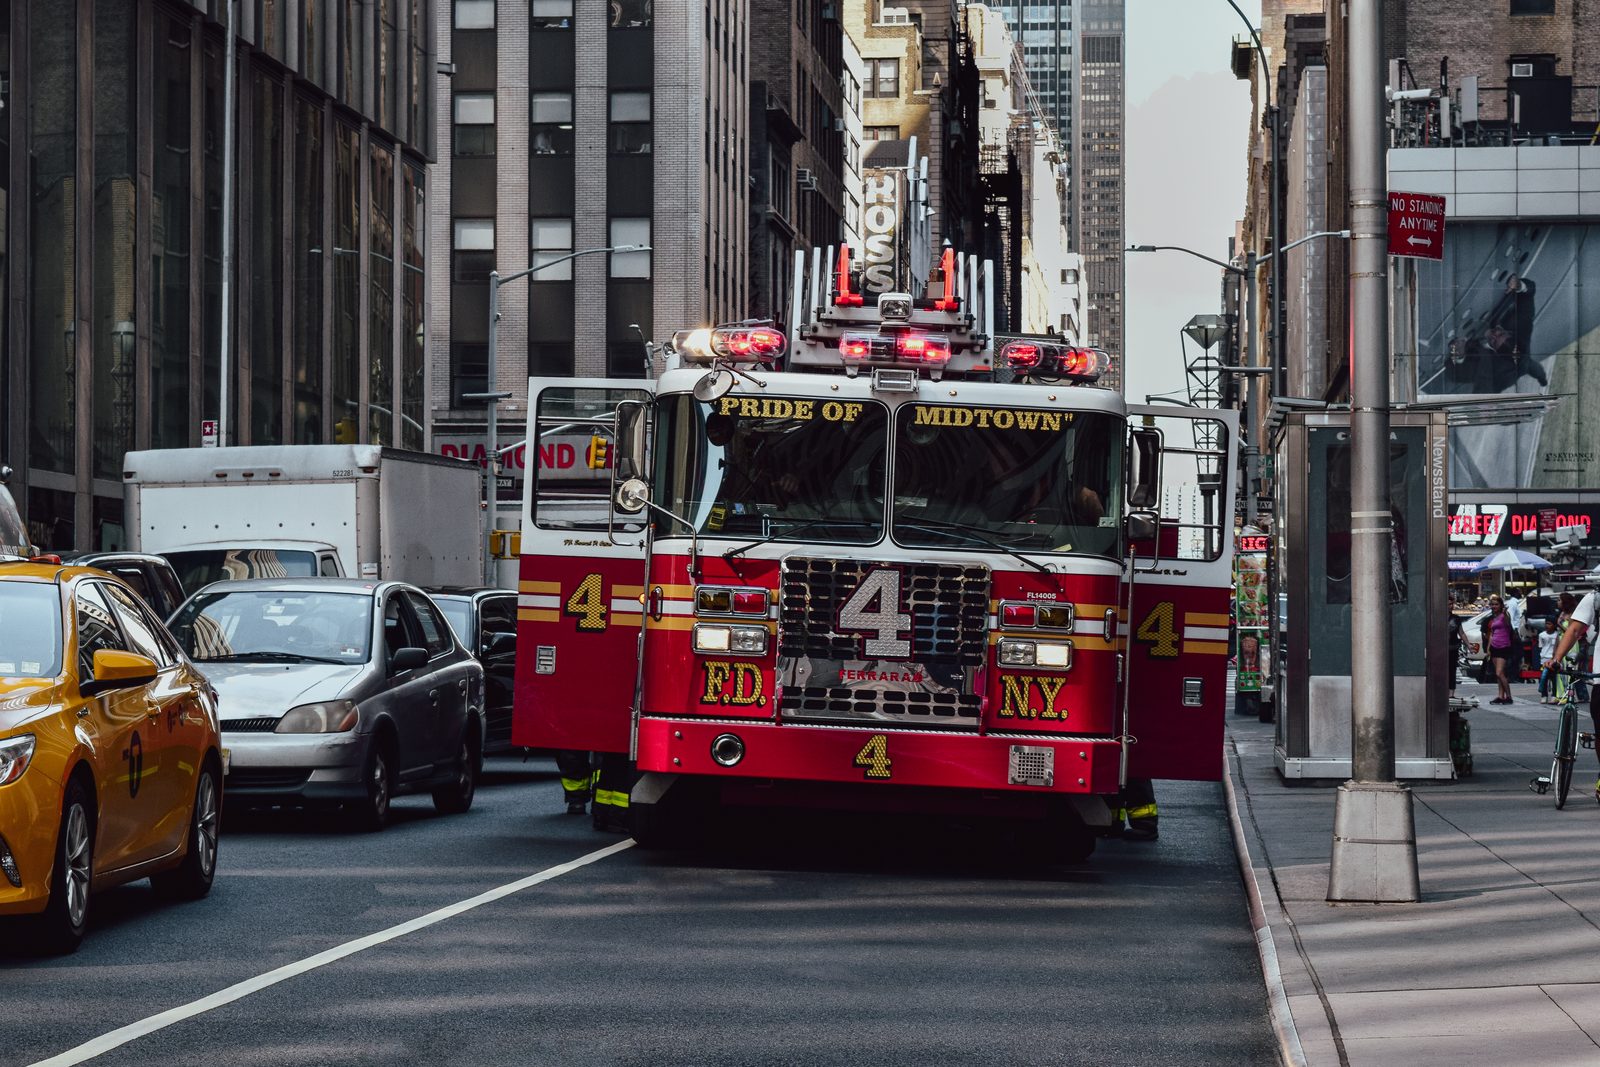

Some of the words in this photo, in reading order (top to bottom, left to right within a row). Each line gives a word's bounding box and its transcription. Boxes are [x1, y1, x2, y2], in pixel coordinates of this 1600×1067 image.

[1391, 198, 1406, 212] NO
[1409, 199, 1443, 216] STANDING
[1399, 216, 1438, 232] ANYTIME
[821, 401, 863, 422] OF
[1432, 436, 1446, 519] Newsstand
[1450, 503, 1509, 546] 47
[1511, 514, 1591, 535] DIAOND
[567, 573, 608, 630] 4
[838, 567, 913, 658] 4
[1136, 601, 1180, 657] 4
[703, 660, 767, 706] F.D.
[1000, 674, 1069, 719] N.Y.
[855, 734, 892, 777] 4
